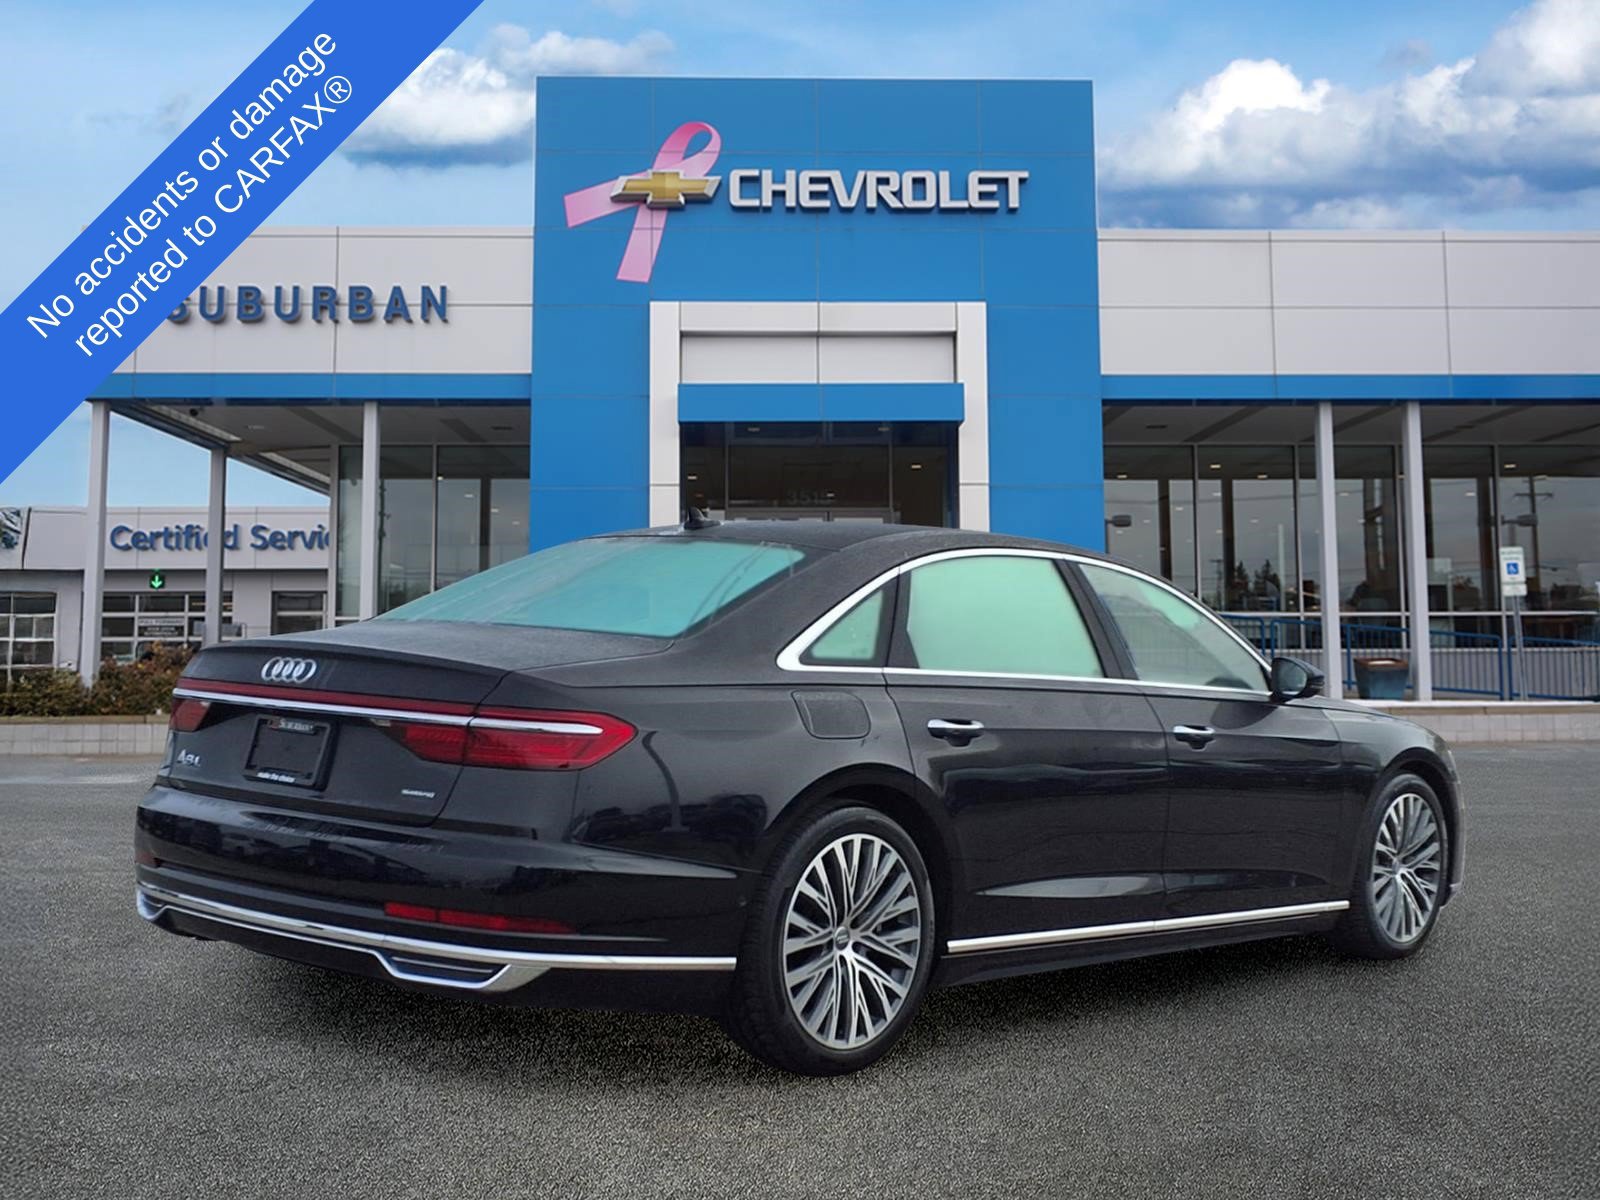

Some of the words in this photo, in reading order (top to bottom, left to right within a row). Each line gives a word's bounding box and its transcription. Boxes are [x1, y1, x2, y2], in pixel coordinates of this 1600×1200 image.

[729, 169, 1029, 209] CHEVROLET
[110, 524, 240, 551] Certifid
[250, 524, 329, 551] Servi
